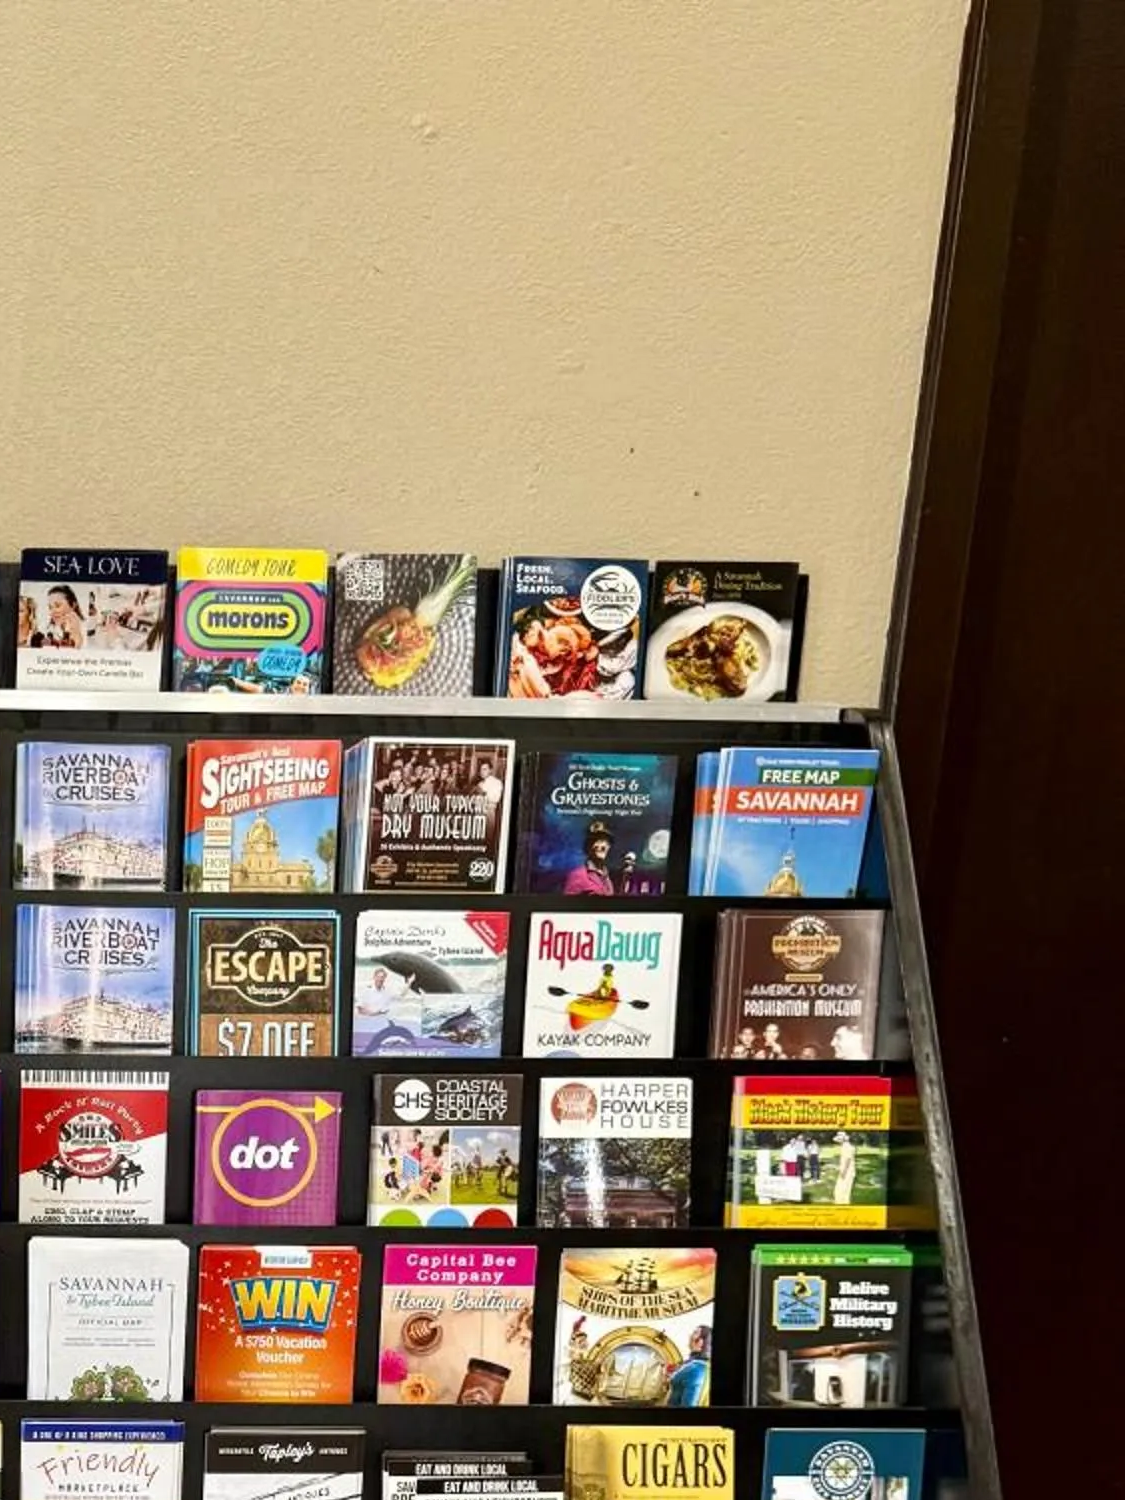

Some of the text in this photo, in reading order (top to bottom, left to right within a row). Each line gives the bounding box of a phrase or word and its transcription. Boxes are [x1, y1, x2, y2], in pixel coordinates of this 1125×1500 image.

[44, 556, 139, 576] SEA LOVE
[517, 563, 553, 573] FRESH.
[516, 573, 553, 584] LOCAL.
[516, 584, 566, 594] SEAFOOD.
[207, 608, 288, 629] morons
[202, 757, 329, 810] SIGHTSEEING
[762, 769, 840, 785] FREE MAP
[551, 787, 651, 807] GRAVESTONES
[736, 791, 858, 811] SAVANNAH
[381, 813, 487, 839] DRY MUSEUM
[538, 919, 661, 969] AquaDawg
[214, 951, 323, 982] ESCAPE
[750, 984, 857, 996] AMERICA'S ONLY
[538, 1034, 651, 1047] KAYAK COMPANY
[437, 1081, 506, 1092] COASTAL
[601, 1084, 688, 1098] HARPER
[436, 1095, 507, 1109] HERITAGE
[601, 1100, 688, 1113] FOWLKES
[434, 1109, 506, 1121] SOCIETY
[601, 1115, 688, 1128] HOUSE
[230, 1137, 300, 1169] dot
[406, 1254, 516, 1269] Capital Bee
[416, 1270, 503, 1284] Company
[839, 1282, 889, 1295] Relive
[235, 1279, 331, 1321] WIN
[829, 1298, 897, 1314] Military
[833, 1315, 893, 1330] History
[37, 1452, 159, 1487] Friendly
[623, 1443, 727, 1488] CIGARS
